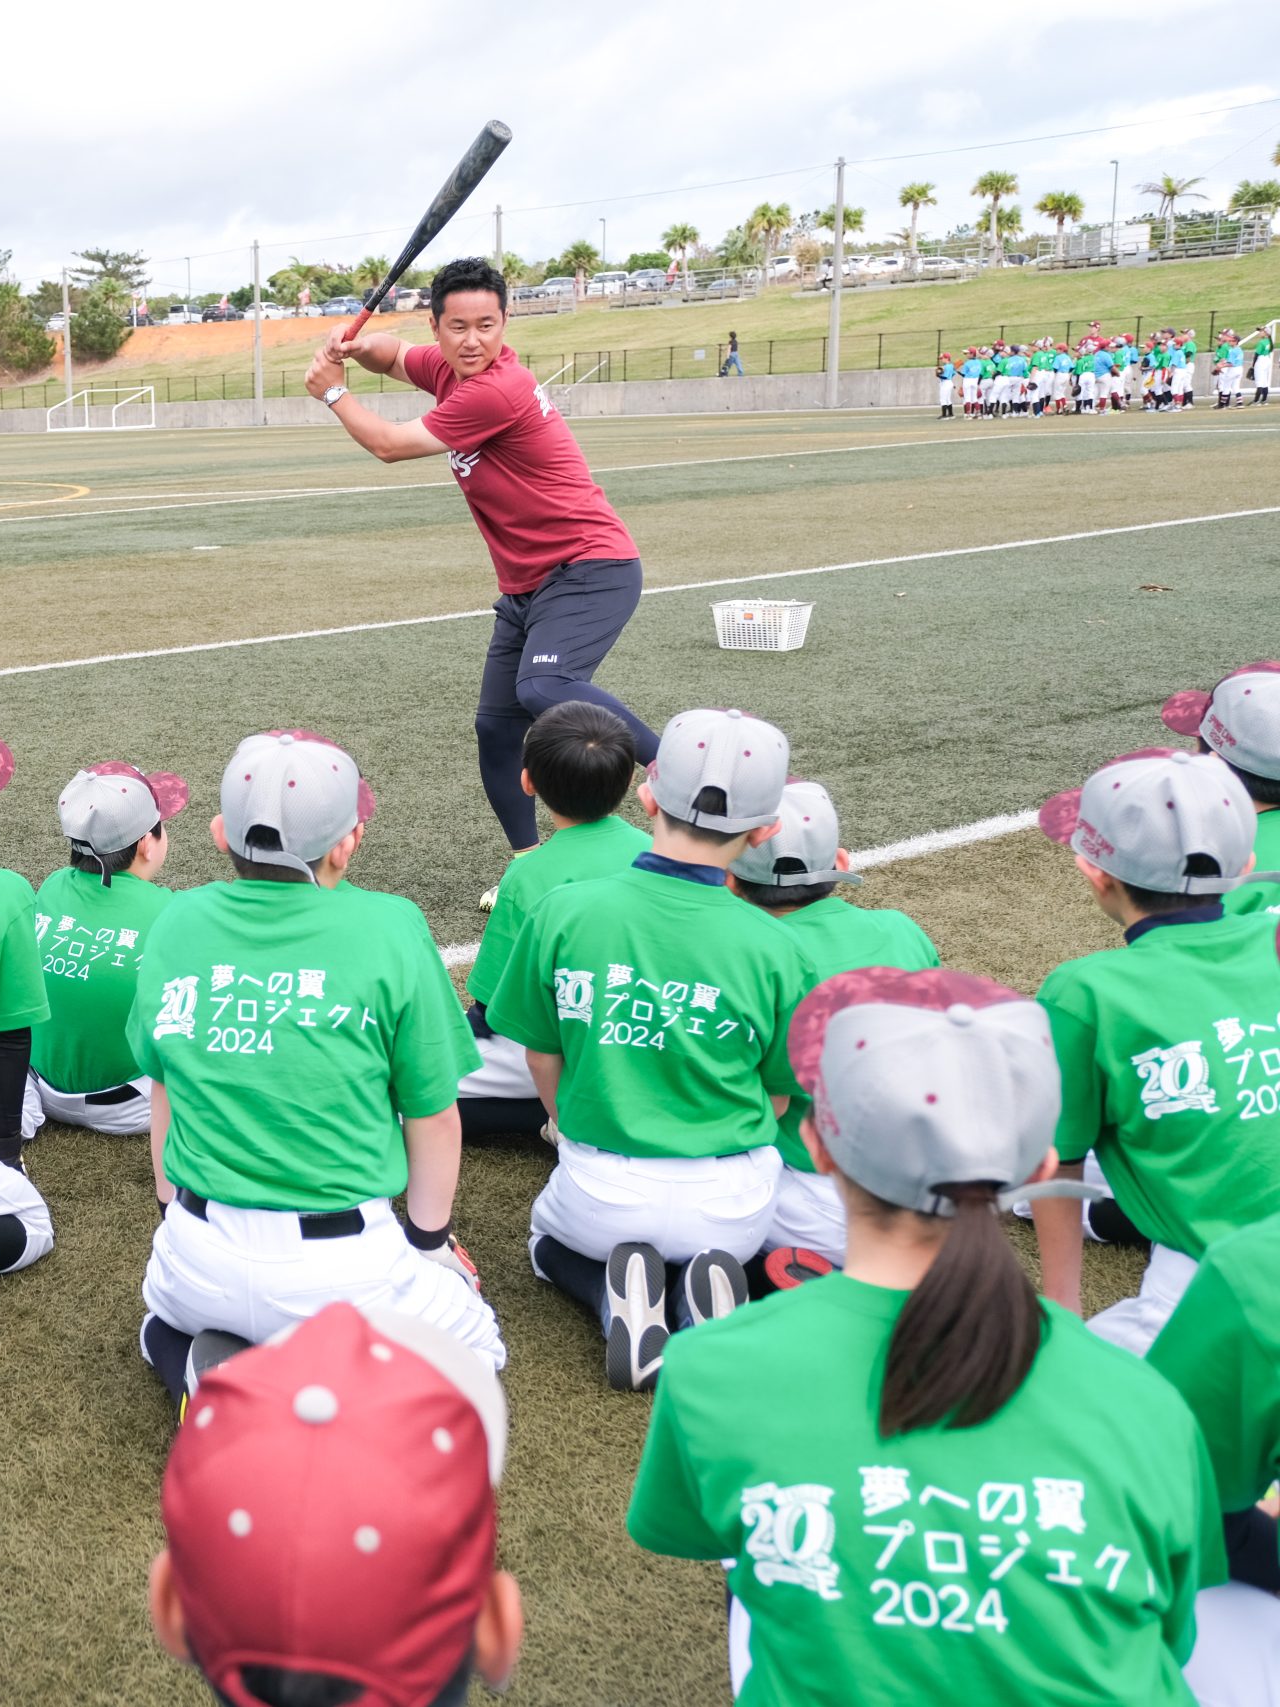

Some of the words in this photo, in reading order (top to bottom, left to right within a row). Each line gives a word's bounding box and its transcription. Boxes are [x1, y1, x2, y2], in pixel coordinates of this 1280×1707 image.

[532, 655, 558, 663] GINJI
[56, 914, 140, 950] 夢への翼
[42, 954, 90, 981] 2024
[211, 964, 326, 999] 夢への翼
[606, 963, 721, 1013] 夢への翼
[209, 993, 377, 1031] プロジェクト
[206, 1026, 274, 1055] 2024
[598, 1021, 665, 1051] 2024
[1212, 1017, 1280, 1053] 夢へ
[1236, 1085, 1280, 1120] 20
[858, 1465, 1087, 1534] 夢への翼
[863, 1519, 1156, 1597] プロジェク
[870, 1578, 1008, 1634] 2024
